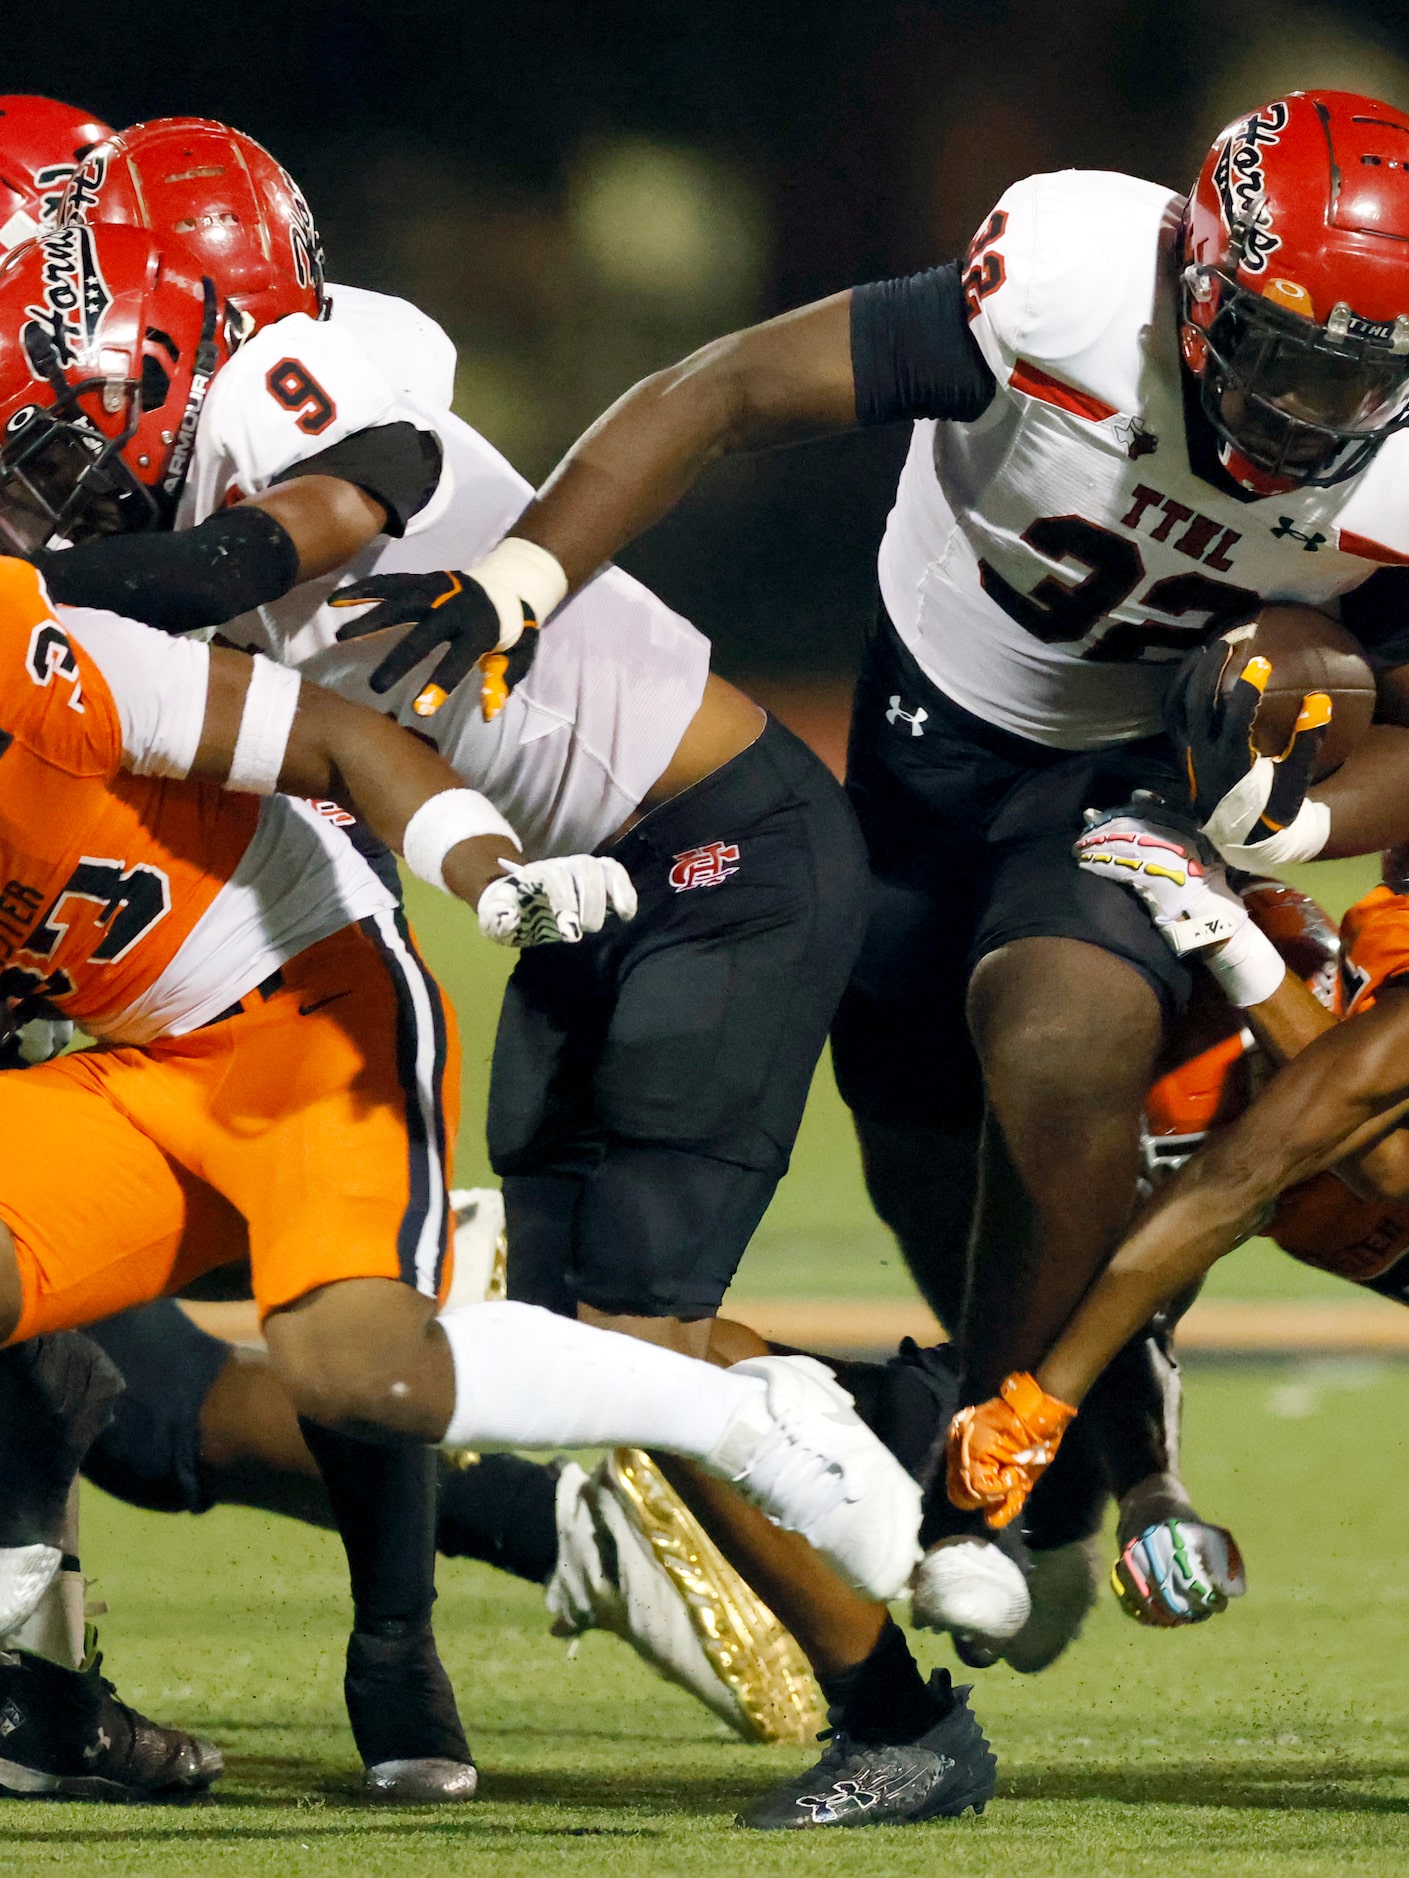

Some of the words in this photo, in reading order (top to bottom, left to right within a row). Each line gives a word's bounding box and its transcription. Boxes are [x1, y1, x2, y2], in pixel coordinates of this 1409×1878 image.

[163, 373, 210, 497] ARMOUR
[265, 356, 337, 436] 9
[1120, 483, 1243, 572] TTHL
[977, 514, 1262, 667] 32
